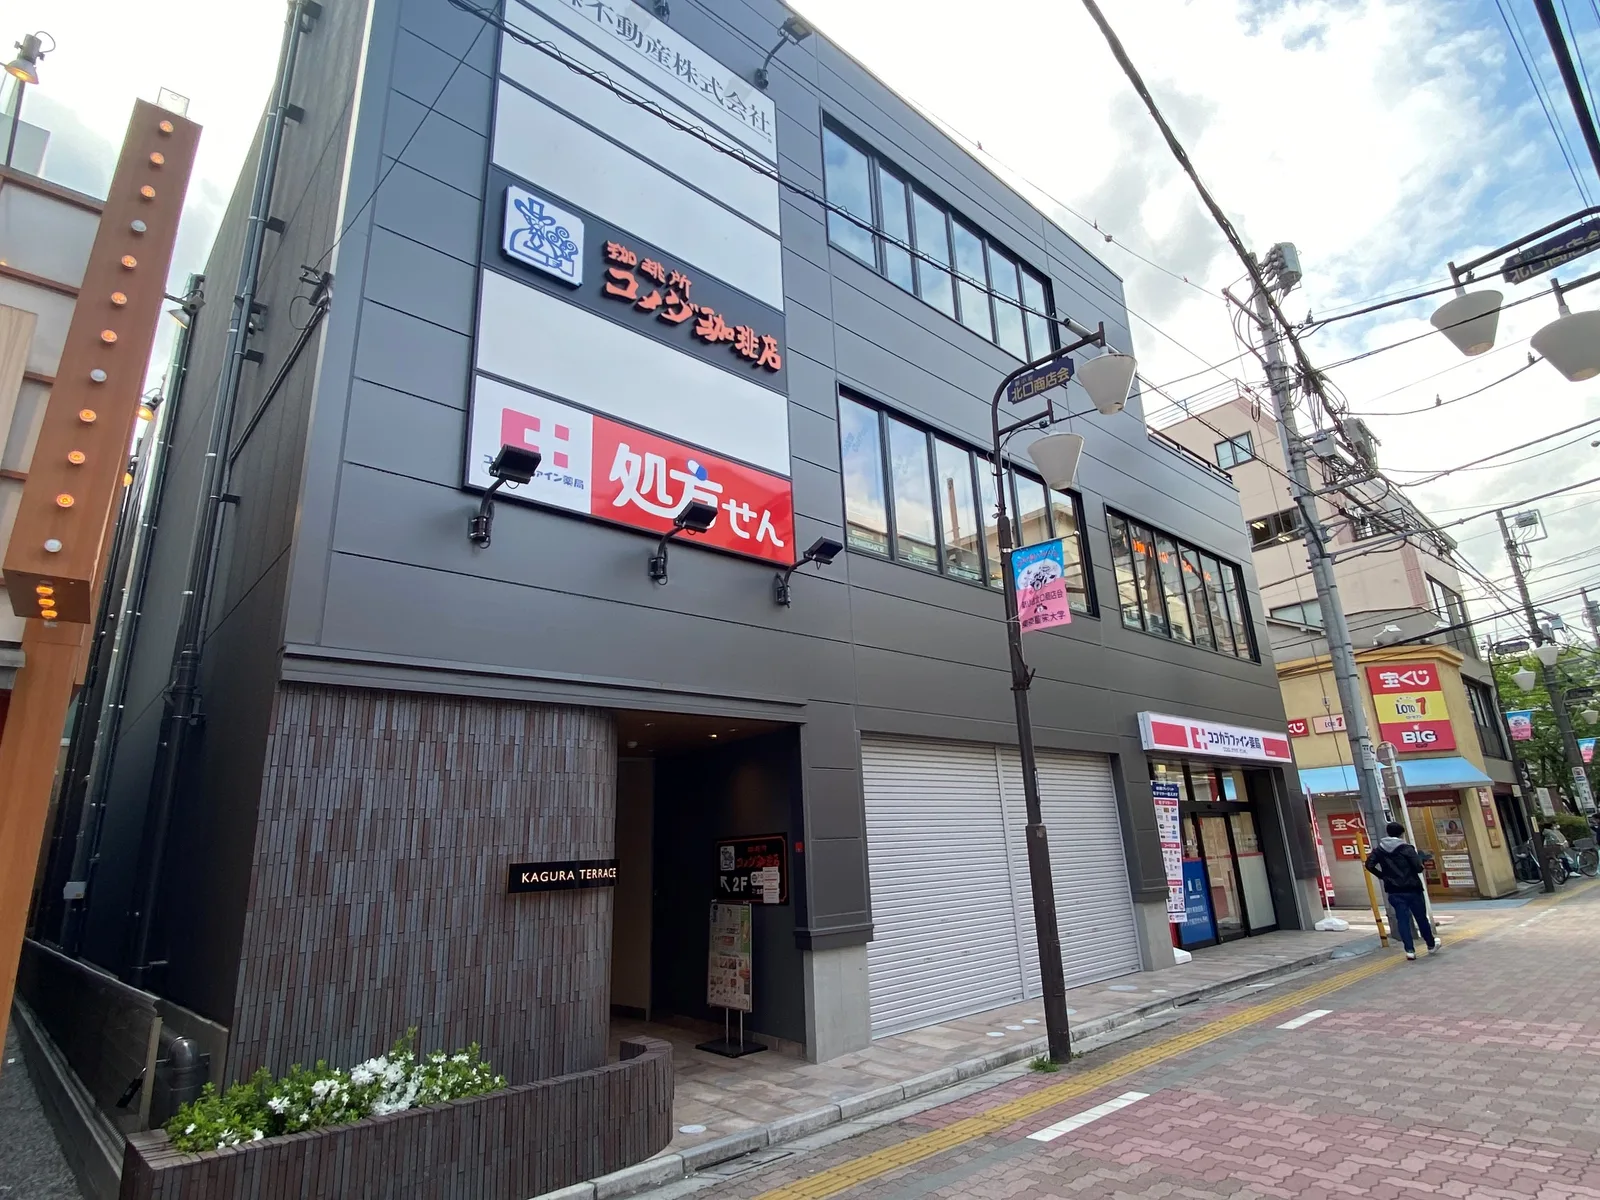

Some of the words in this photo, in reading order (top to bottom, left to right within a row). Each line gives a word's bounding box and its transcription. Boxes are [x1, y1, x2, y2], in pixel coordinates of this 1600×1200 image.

[572, 0, 772, 137] 不動産株式会社
[1011, 367, 1070, 402] 北口商店会
[609, 442, 785, 548] 処方せん
[1379, 669, 1430, 688] 宝くじ
[1395, 703, 1416, 714] LOTO
[1415, 696, 1427, 715] 7
[1336, 717, 1343, 727] 7
[1207, 731, 1261, 749] ココカラファイン薬局
[1401, 727, 1437, 744] BIG
[521, 870, 575, 883] KAGURA
[579, 867, 617, 880] TERRACE
[732, 876, 748, 892] 2F
